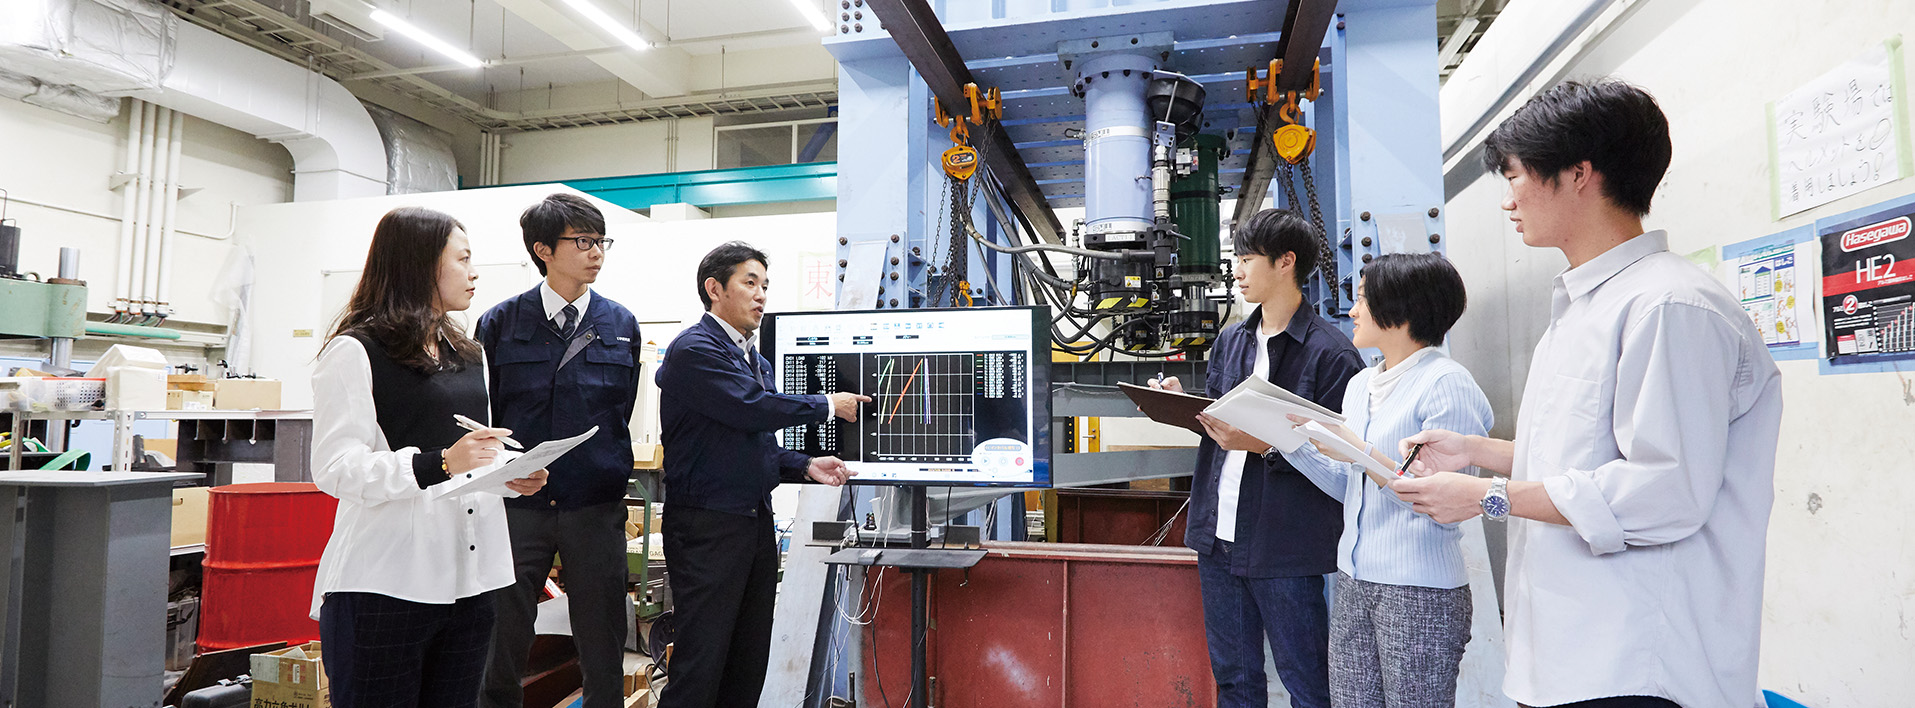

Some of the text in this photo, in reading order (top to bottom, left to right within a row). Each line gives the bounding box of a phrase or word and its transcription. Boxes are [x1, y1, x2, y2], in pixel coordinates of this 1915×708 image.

[1784, 79, 1893, 144] 実験場では
[1845, 222, 1907, 247] Hasegawa
[805, 260, 833, 300] 東
[1856, 253, 1896, 284] HE2
